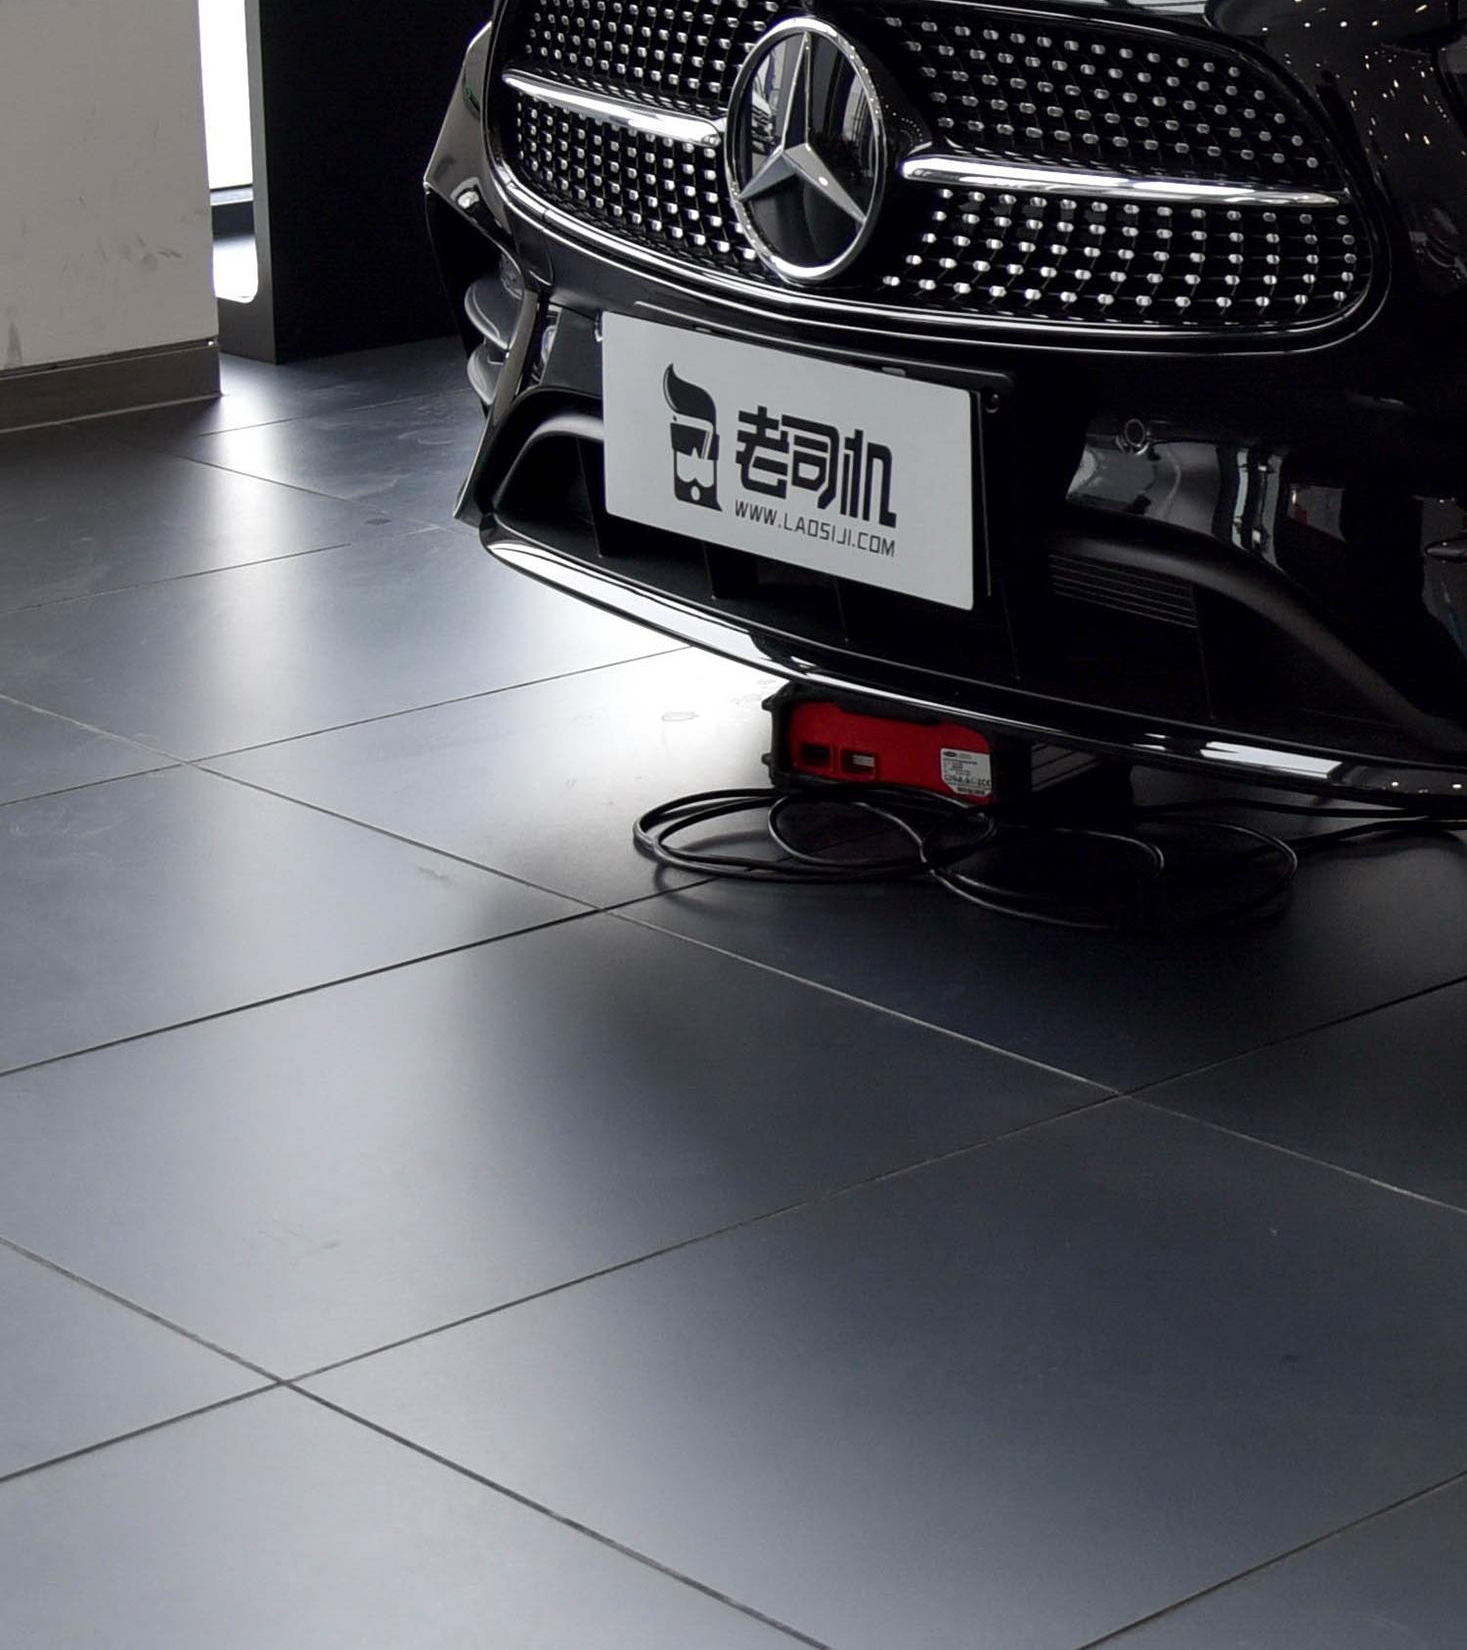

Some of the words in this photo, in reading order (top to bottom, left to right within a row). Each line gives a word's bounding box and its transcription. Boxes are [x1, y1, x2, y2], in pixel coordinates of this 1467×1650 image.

[735, 405, 897, 528] 老司机
[734, 499, 895, 557] WWW.LAOSIJI.COM
